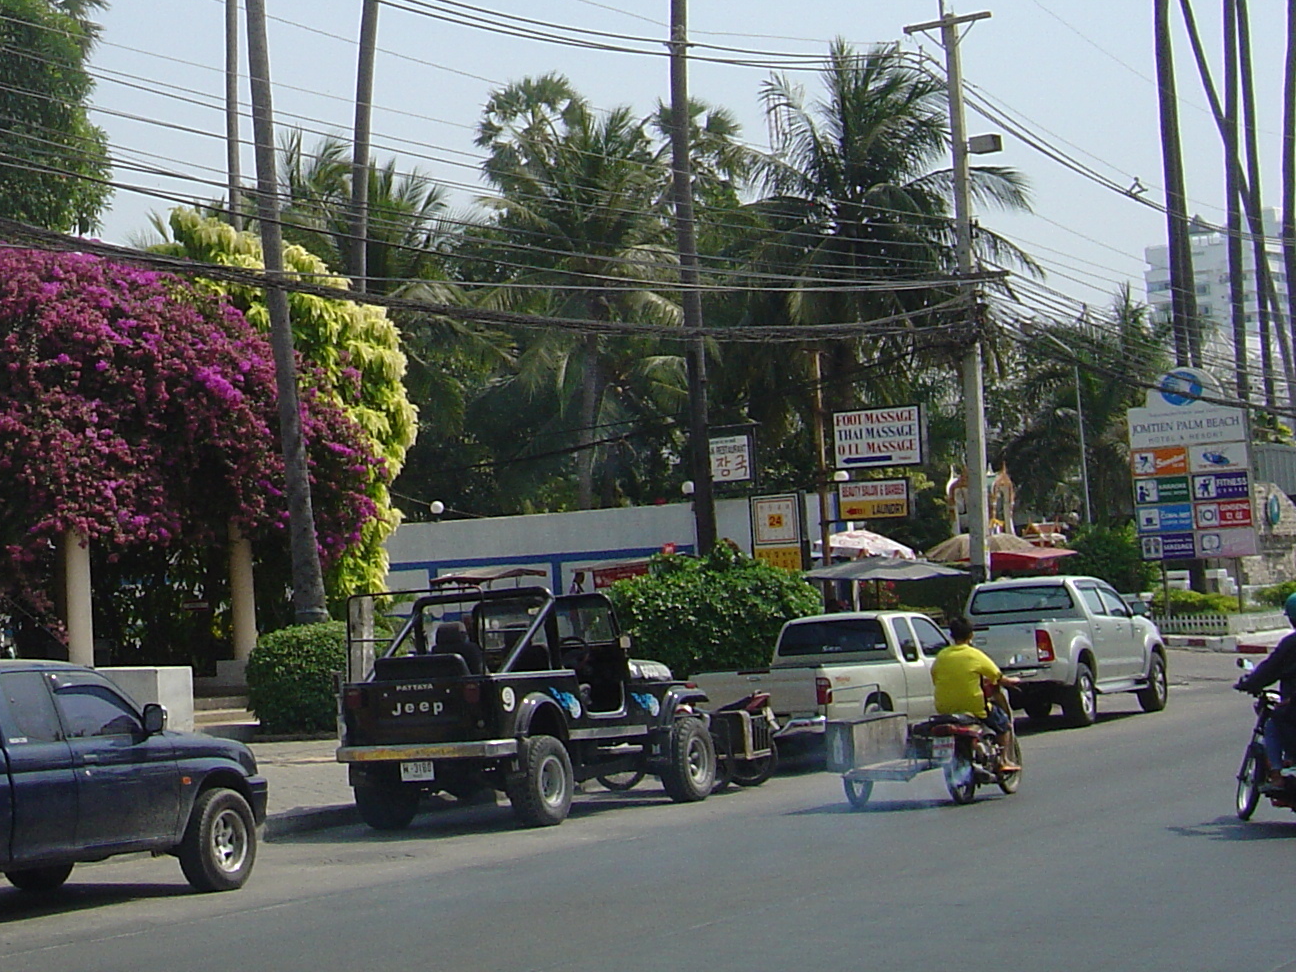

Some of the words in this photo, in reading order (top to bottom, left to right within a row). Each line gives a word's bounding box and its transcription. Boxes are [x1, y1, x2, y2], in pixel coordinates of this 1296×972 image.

[835, 414, 863, 427] FOOT
[865, 410, 916, 425] MASSAGE
[837, 428, 863, 442] THAI
[866, 424, 916, 439] MASSAGE
[1132, 421, 1174, 437] JOMTIEN
[1176, 419, 1203, 431] PALM
[1206, 416, 1240, 428] BEACH
[1148, 435, 1176, 444] HOTEL
[1189, 431, 1224, 440] RESORT
[837, 443, 861, 456] OIL
[867, 439, 917, 453] MASSAGE
[1215, 476, 1248, 487] FITNESS
[841, 485, 861, 498] BEAUTY
[1217, 486, 1248, 494] CENTER
[872, 503, 904, 516] LAUNDRY
[1220, 502, 1250, 512] GINSENG
[769, 515, 782, 527] 24
[396, 683, 433, 692] PATTAYA
[501, 686, 516, 712] 9
[392, 700, 444, 716] Jeep
